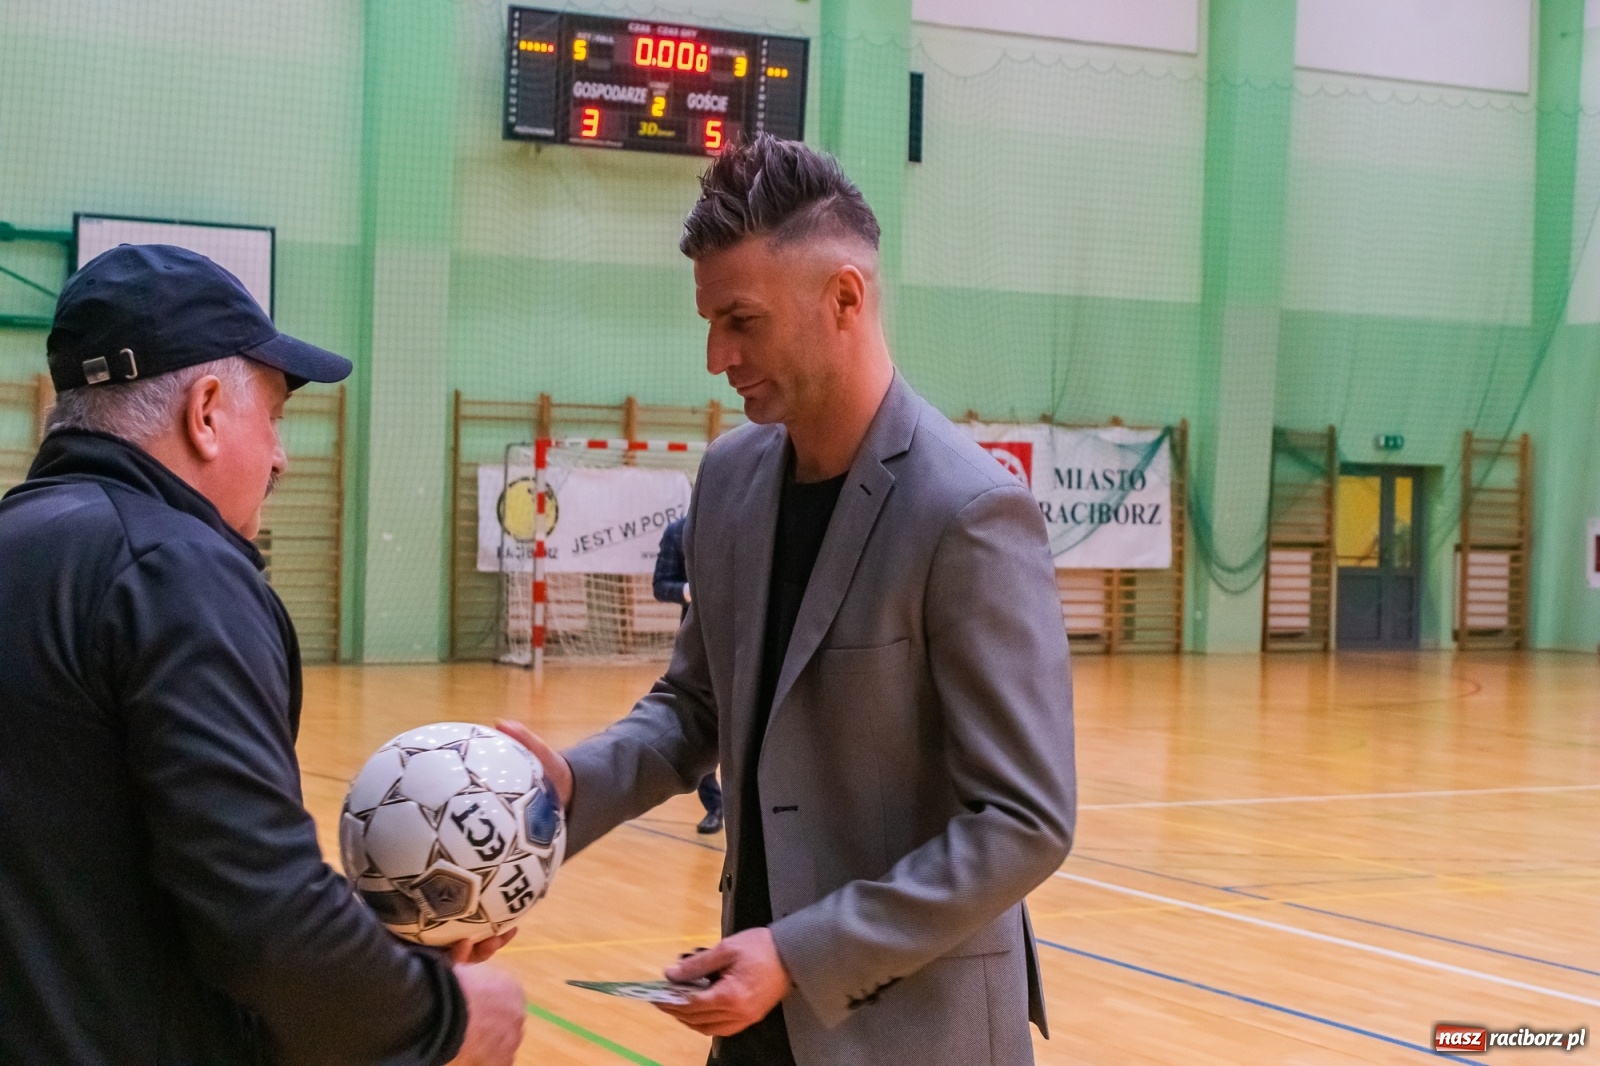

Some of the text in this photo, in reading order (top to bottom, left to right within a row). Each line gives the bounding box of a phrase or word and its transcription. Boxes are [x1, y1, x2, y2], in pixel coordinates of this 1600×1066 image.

[573, 40, 587, 60] 5
[734, 56, 747, 77] 3
[573, 81, 648, 104] GOSPODARZE
[686, 90, 729, 112] GOŚCIE
[651, 97, 666, 117] 2
[581, 108, 600, 137] 3
[705, 120, 721, 149] 5
[1053, 467, 1147, 491] MIASTO
[572, 527, 613, 553] JEST
[619, 521, 636, 538] W
